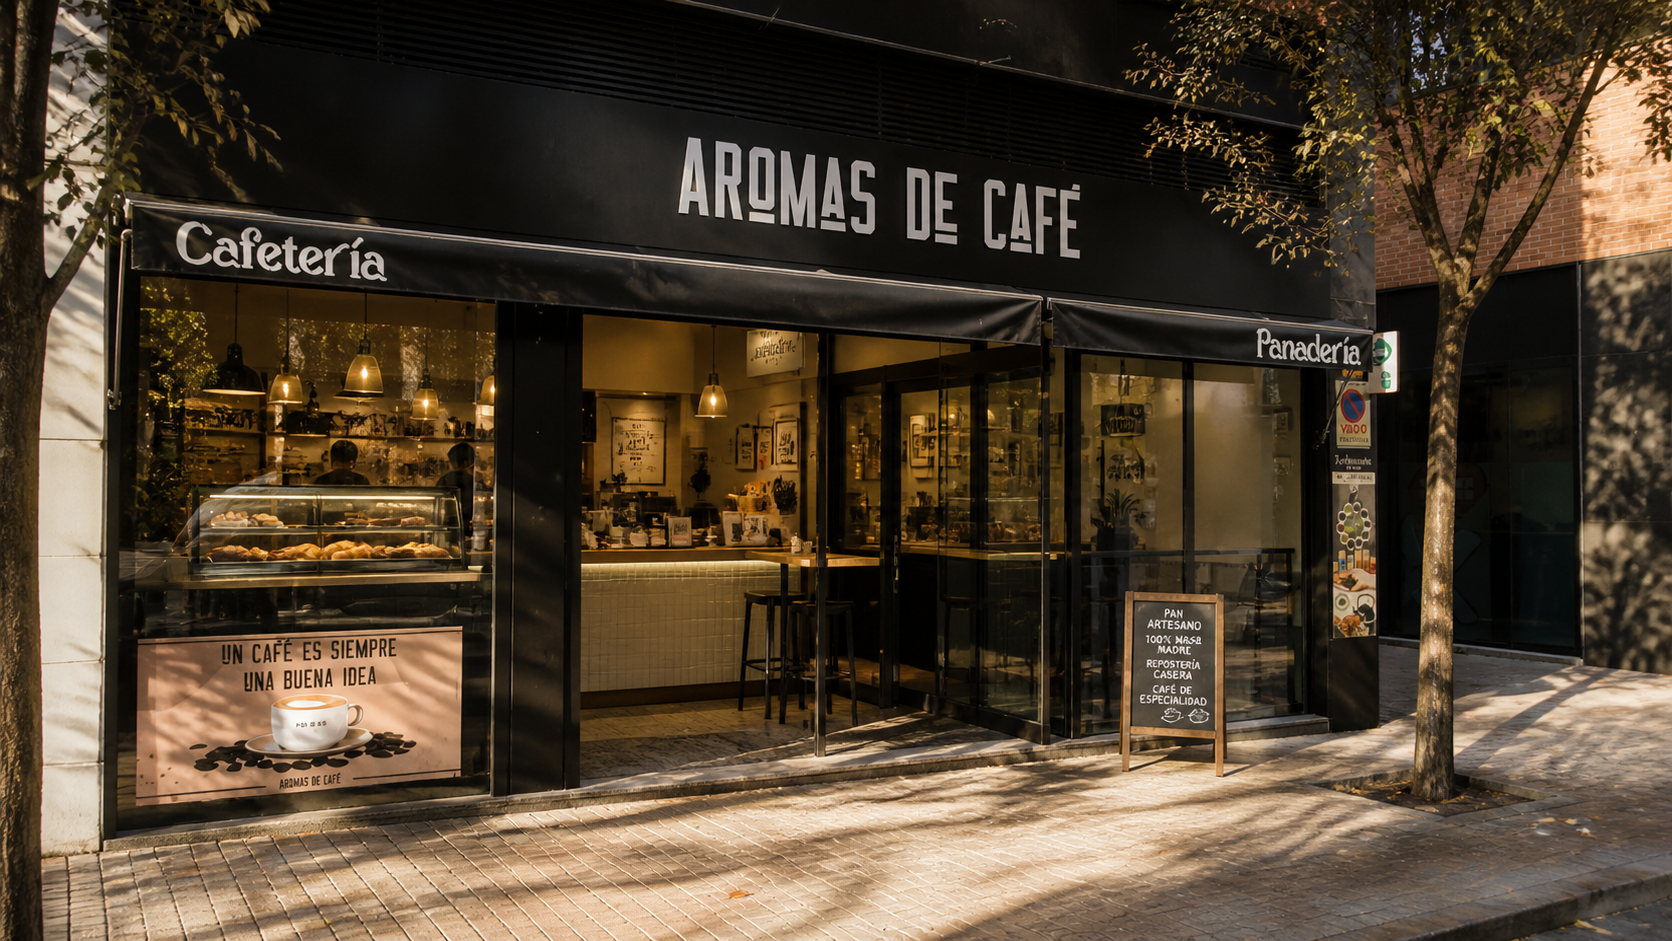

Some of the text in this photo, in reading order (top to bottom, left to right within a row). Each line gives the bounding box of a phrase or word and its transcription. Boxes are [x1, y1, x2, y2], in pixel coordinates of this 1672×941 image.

[678, 136, 1081, 259] AROMAS DE CAFÉ
[177, 220, 387, 282] Cafetería
[1256, 327, 1361, 366] Panadería
[1164, 608, 1183, 618] PAN
[1147, 619, 1202, 630] ARTESANO
[1145, 635, 1171, 644] 100%
[222, 638, 396, 664] UN CAFÉ ES SIEMPRE
[1157, 645, 1191, 655] MADRE
[1147, 658, 1200, 670] REPOSTERÍA
[244, 666, 376, 692] UNA BUENA IDEA
[1153, 670, 1192, 680] CASERA
[1152, 684, 1192, 695] CAFÉ DE
[1140, 694, 1207, 706] ESPECIALIDAD
[279, 773, 341, 789] AROMAS DE CAFÉ
